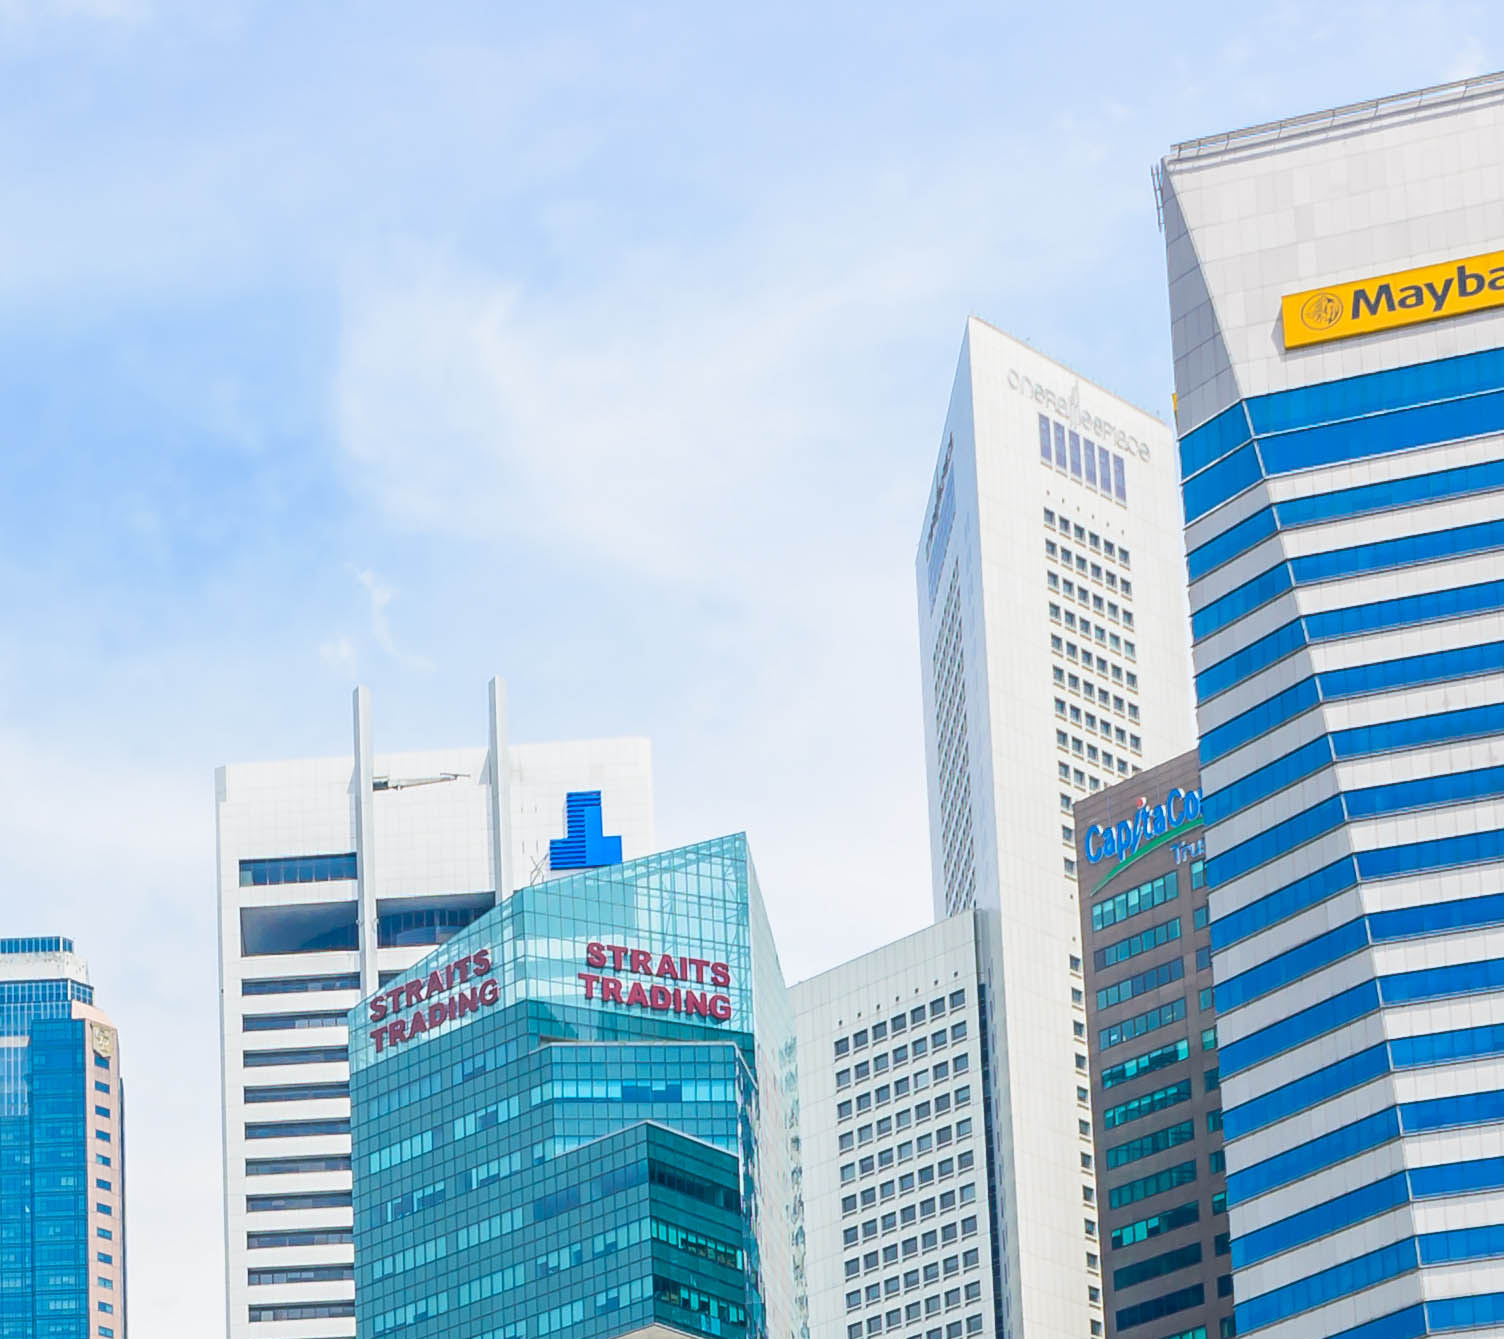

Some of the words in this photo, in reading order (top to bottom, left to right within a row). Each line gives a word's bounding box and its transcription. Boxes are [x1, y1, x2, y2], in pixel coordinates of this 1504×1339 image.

[1084, 787, 1203, 863] CapitaCo
[1170, 839, 1205, 864] Tru
[369, 948, 492, 1022] STRAITS
[586, 941, 732, 988] STRAITS
[369, 978, 501, 1054] TRADING
[578, 972, 733, 1021] TRADING
